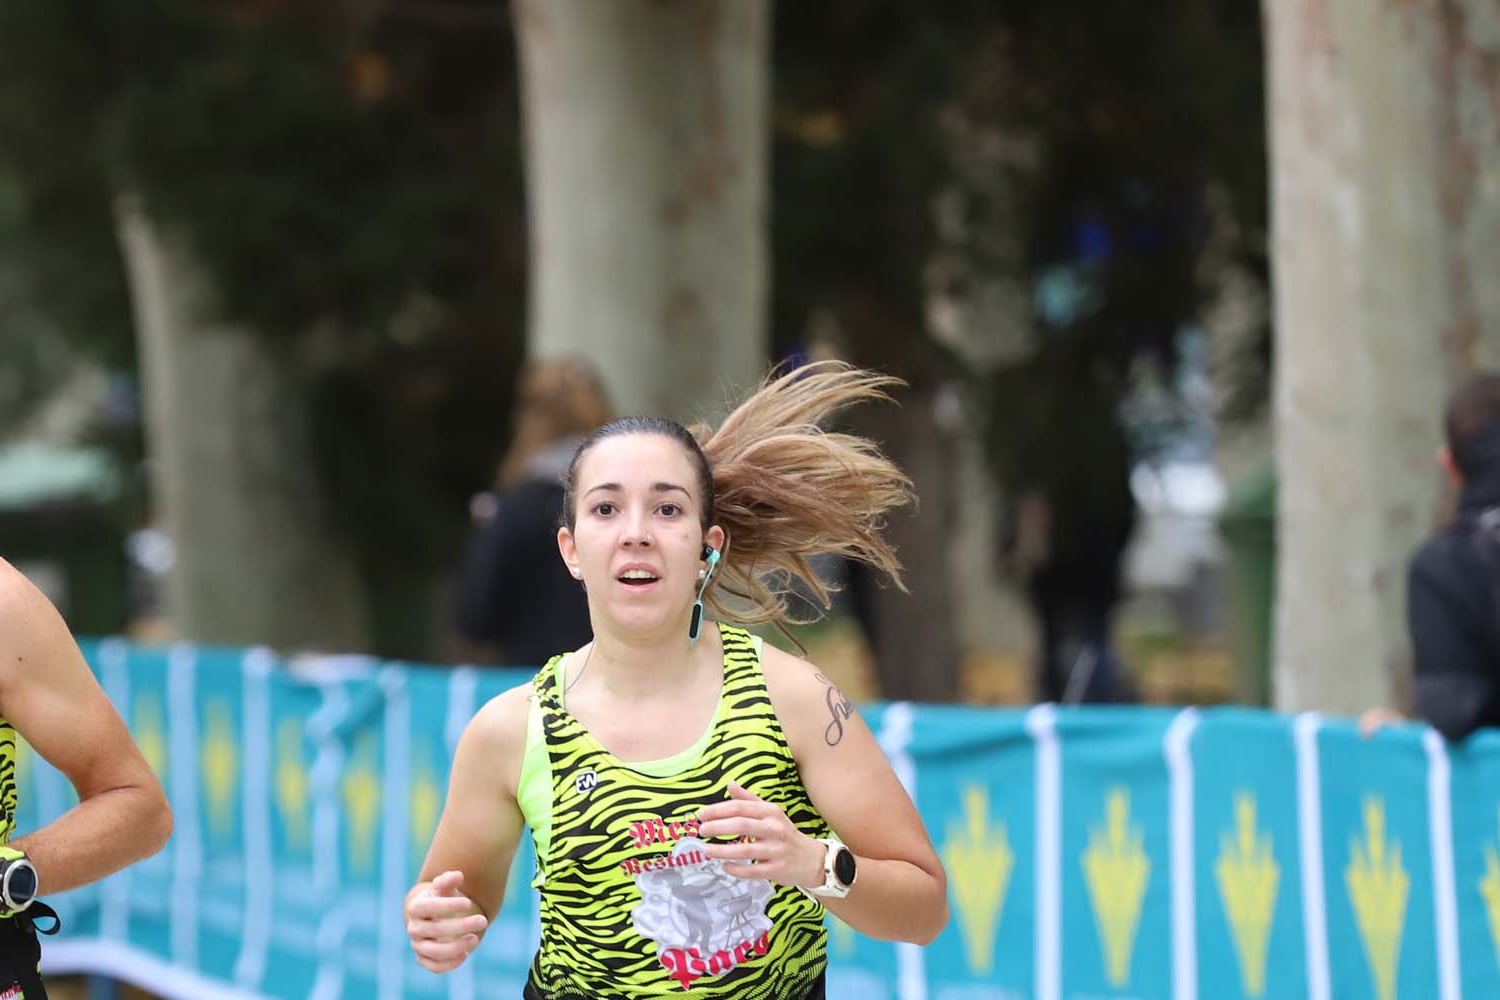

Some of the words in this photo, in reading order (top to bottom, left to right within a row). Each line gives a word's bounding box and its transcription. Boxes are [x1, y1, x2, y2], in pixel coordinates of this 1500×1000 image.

[629, 816, 702, 849] Mes
[619, 848, 714, 877] Restau
[660, 930, 770, 991] Paco
